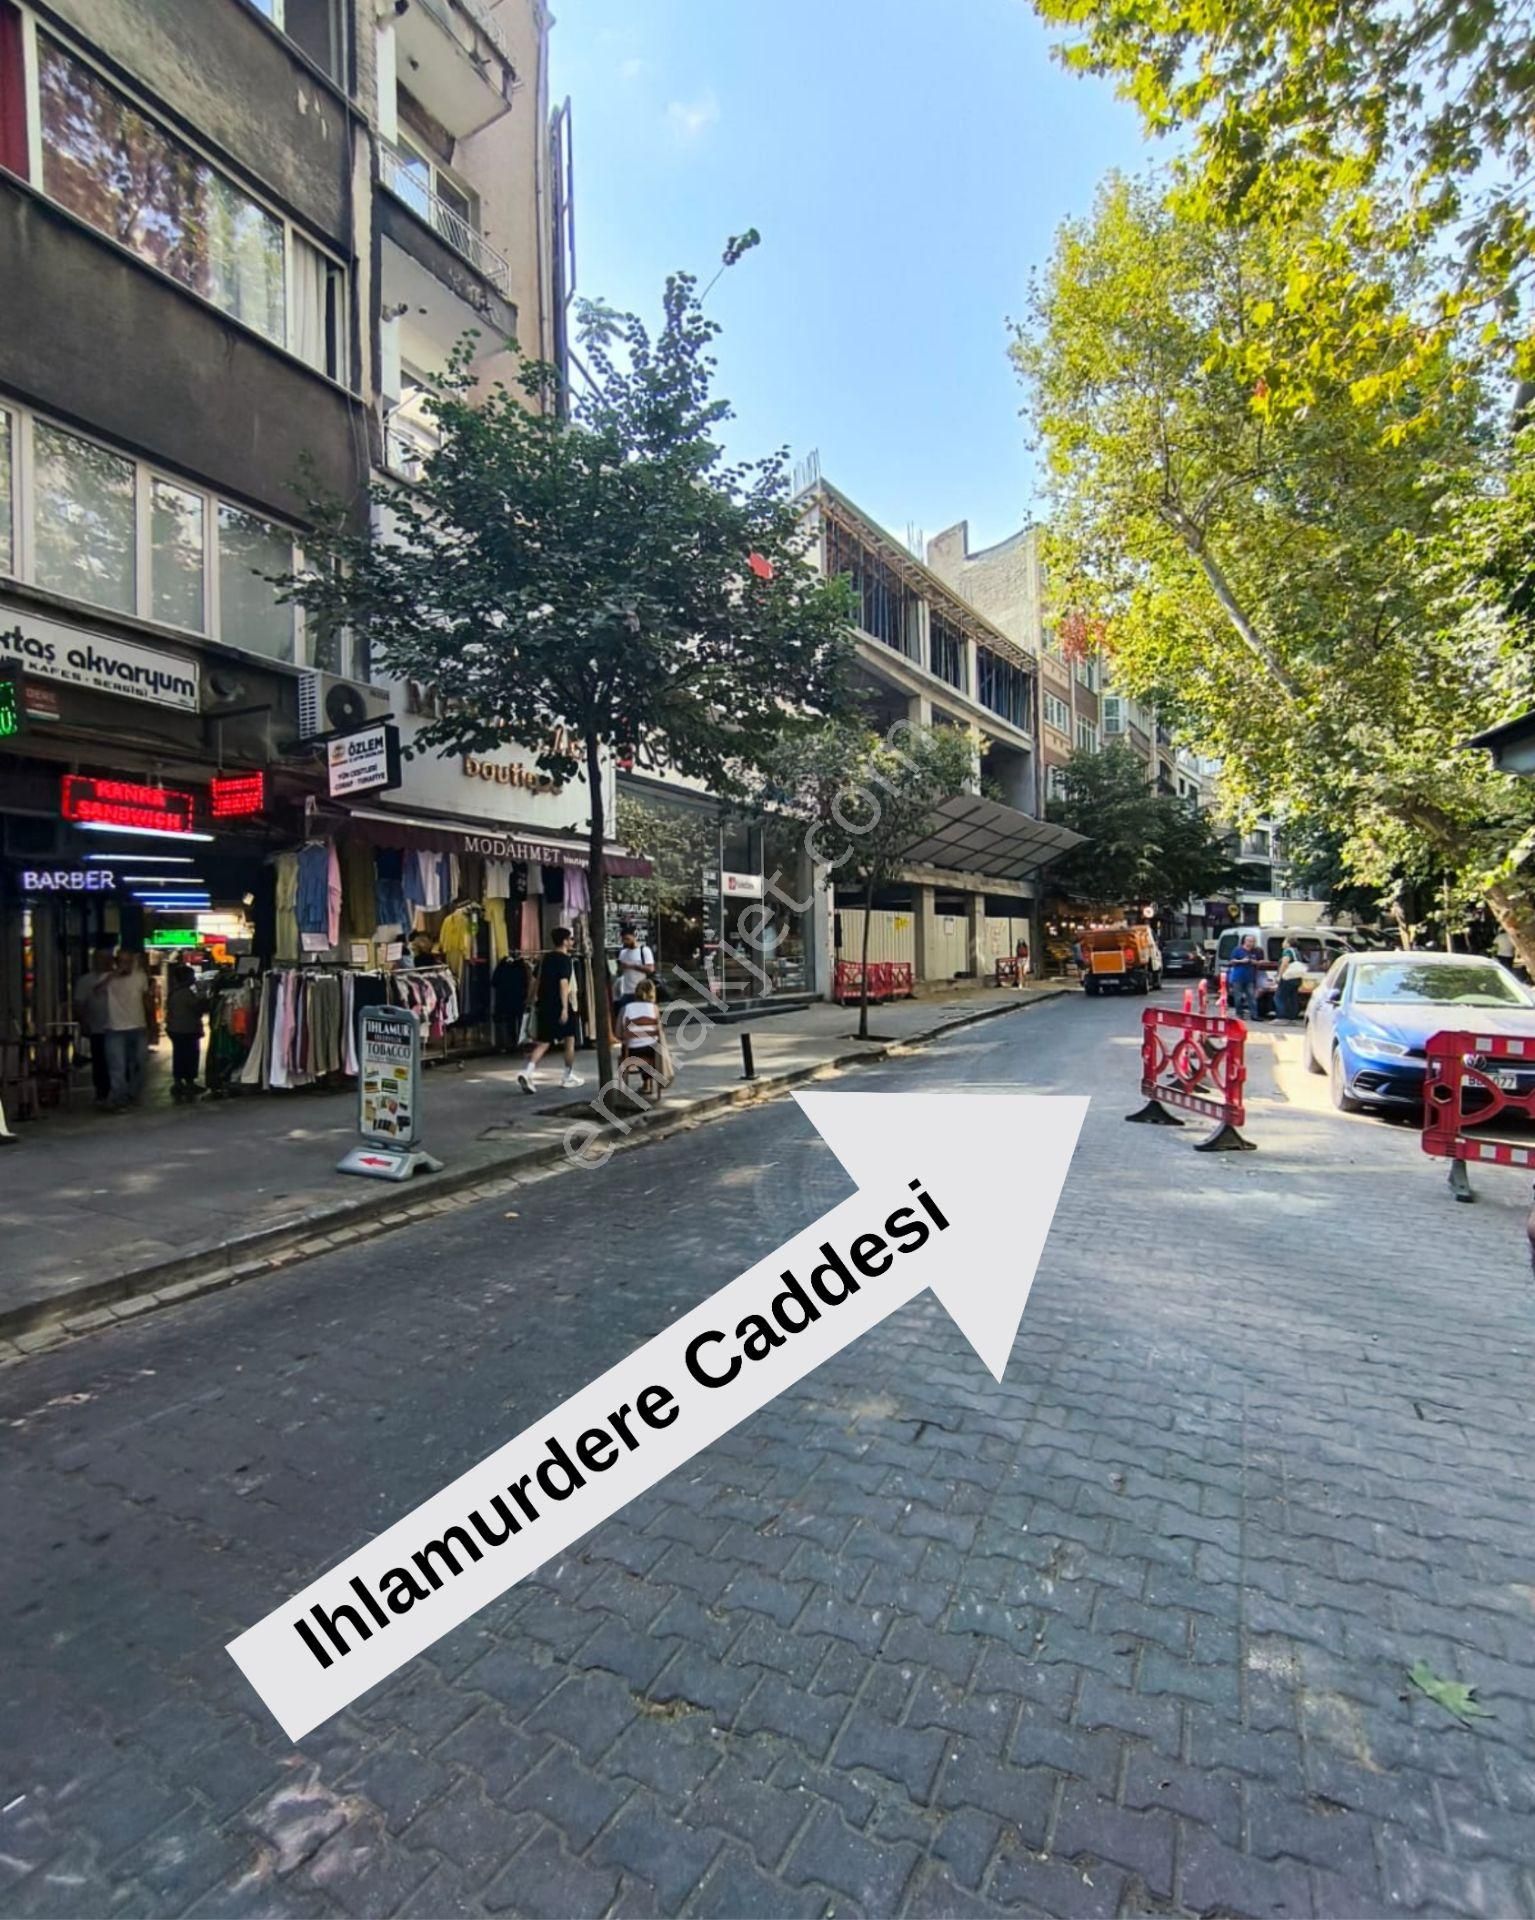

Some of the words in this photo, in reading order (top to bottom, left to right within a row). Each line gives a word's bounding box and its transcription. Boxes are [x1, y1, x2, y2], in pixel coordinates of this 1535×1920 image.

[29, 662, 81, 681] KAFES
[67, 645, 195, 697] akvaryum
[348, 736, 384, 756] ÖZLEM
[76, 800, 182, 830] SANDWICH
[465, 836, 560, 863] MODAHMET
[23, 871, 116, 890] BARBER
[367, 1043, 411, 1058] TOBACCO
